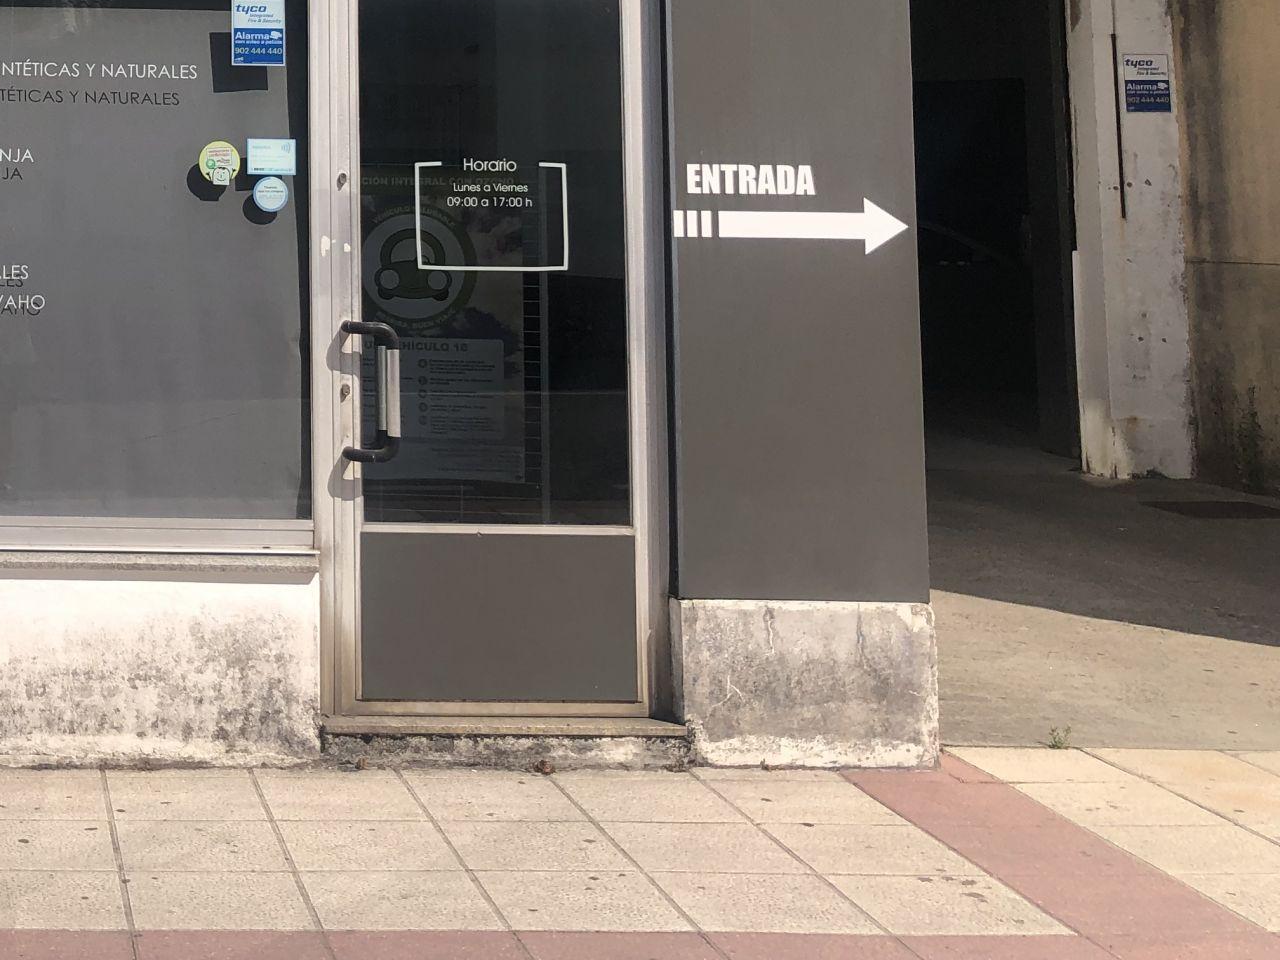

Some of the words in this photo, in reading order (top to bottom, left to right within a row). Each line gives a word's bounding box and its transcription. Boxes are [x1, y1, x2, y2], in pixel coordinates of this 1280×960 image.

[235, 4, 267, 15] tyco
[235, 31, 270, 40] Alarma
[251, 47, 266, 55] 444
[1124, 59, 1153, 68] tyco
[85, 63, 96, 78] Y
[101, 63, 198, 80] NATURALES
[463, 157, 517, 172] Horario
[686, 163, 816, 196] ENTRADA
[453, 182, 481, 192] Lunes
[483, 184, 491, 192] a
[493, 183, 529, 193] Viernes
[446, 196, 478, 207] 09:00
[481, 198, 489, 207] a
[493, 196, 523, 207] 17:00
[525, 197, 533, 207] h
